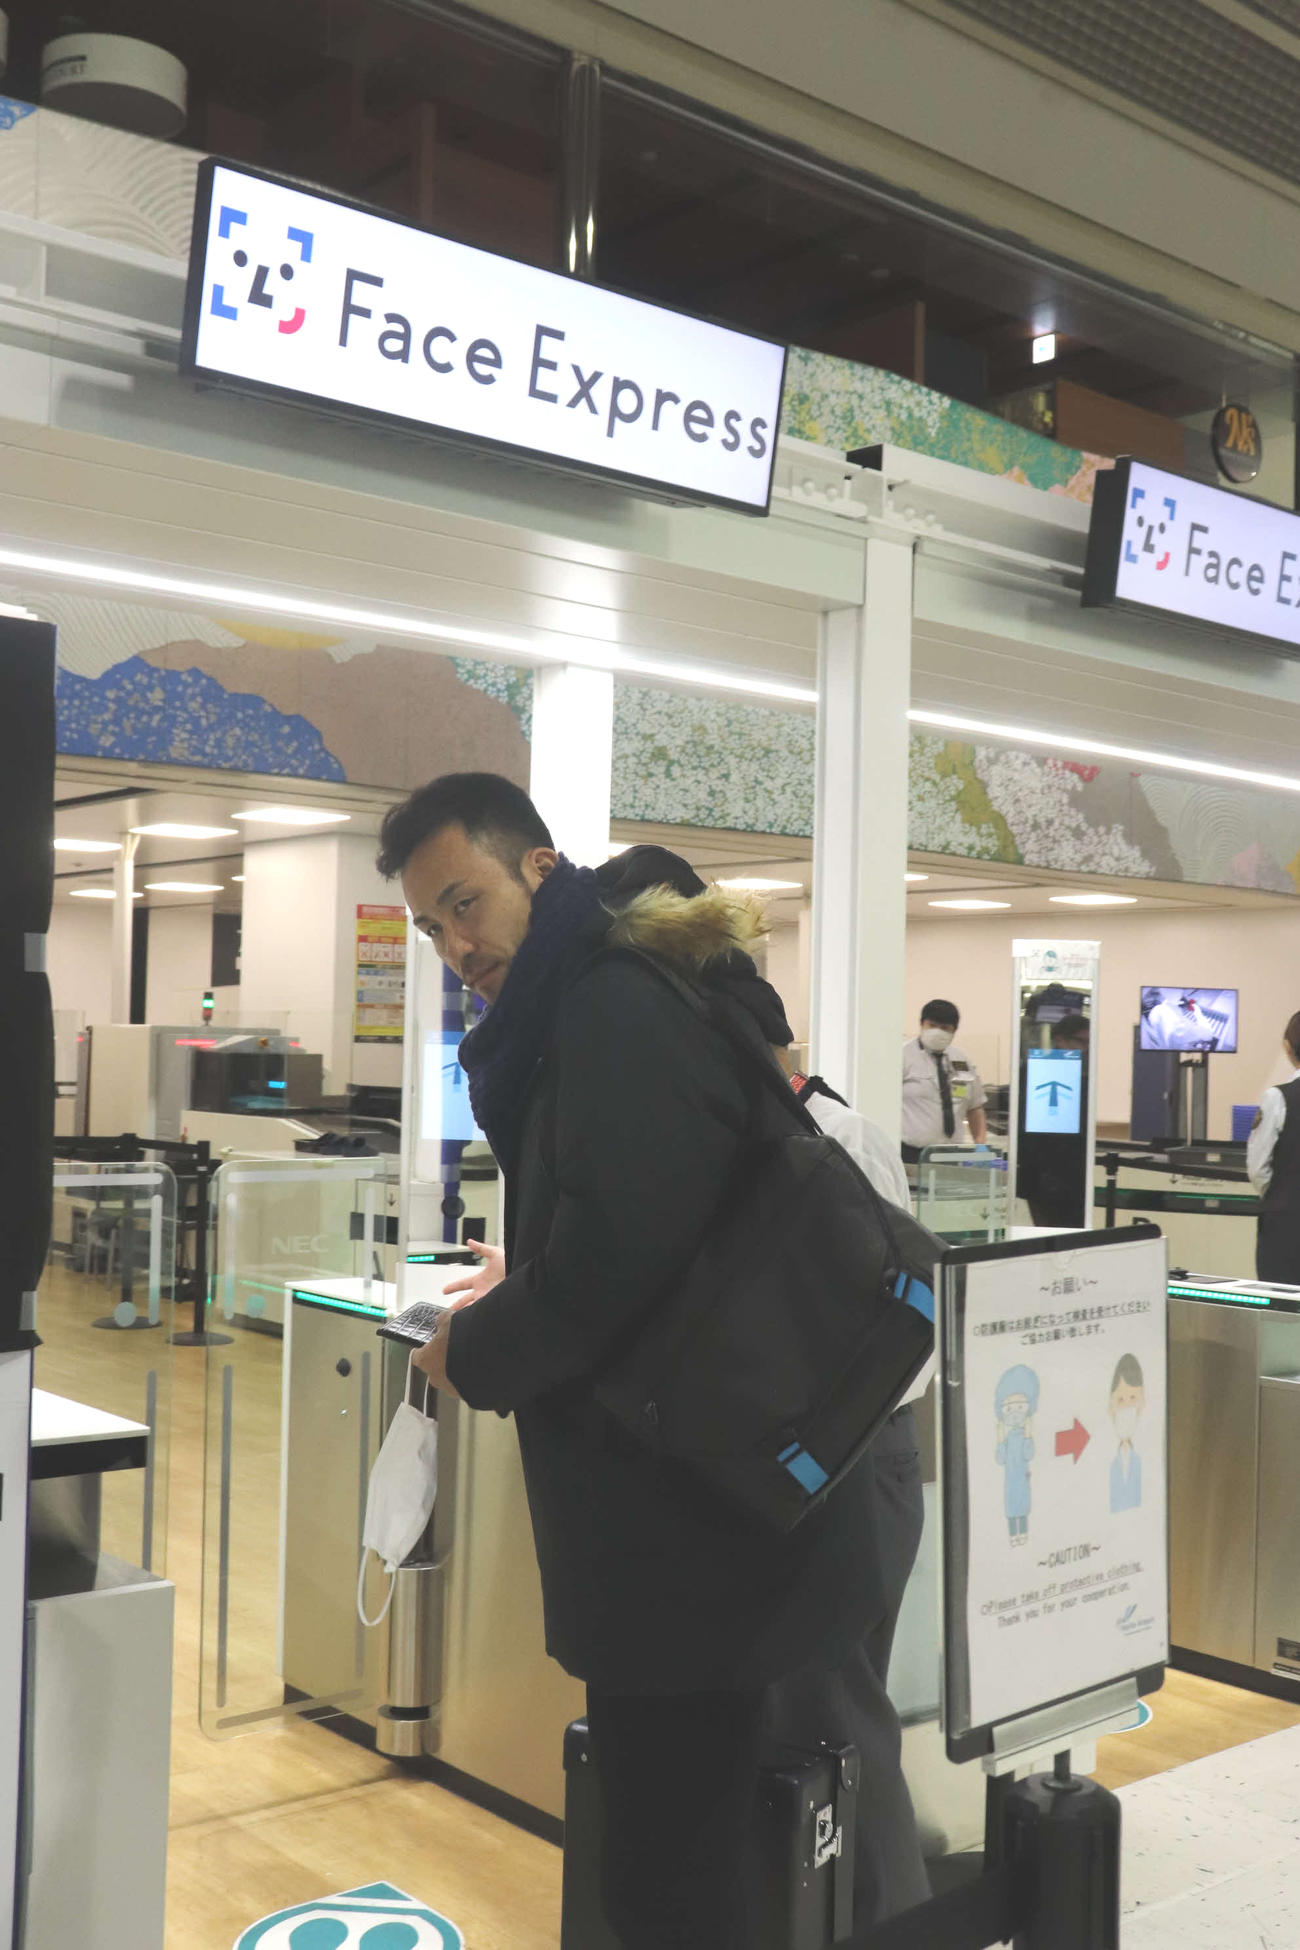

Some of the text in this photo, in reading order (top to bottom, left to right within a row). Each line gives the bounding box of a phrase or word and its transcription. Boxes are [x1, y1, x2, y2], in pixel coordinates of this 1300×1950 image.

[338, 267, 769, 459] Face Express
[1185, 521, 1300, 608] Face E
[272, 1234, 329, 1256] NEC
[1021, 1589, 1039, 1604] take
[1043, 1583, 1057, 1598] off
[1060, 1571, 1105, 1593] protective
[997, 1612, 1021, 1628] Thank
[1025, 1608, 1039, 1622] you
[1043, 1602, 1057, 1615] for
[1060, 1597, 1078, 1611] your
